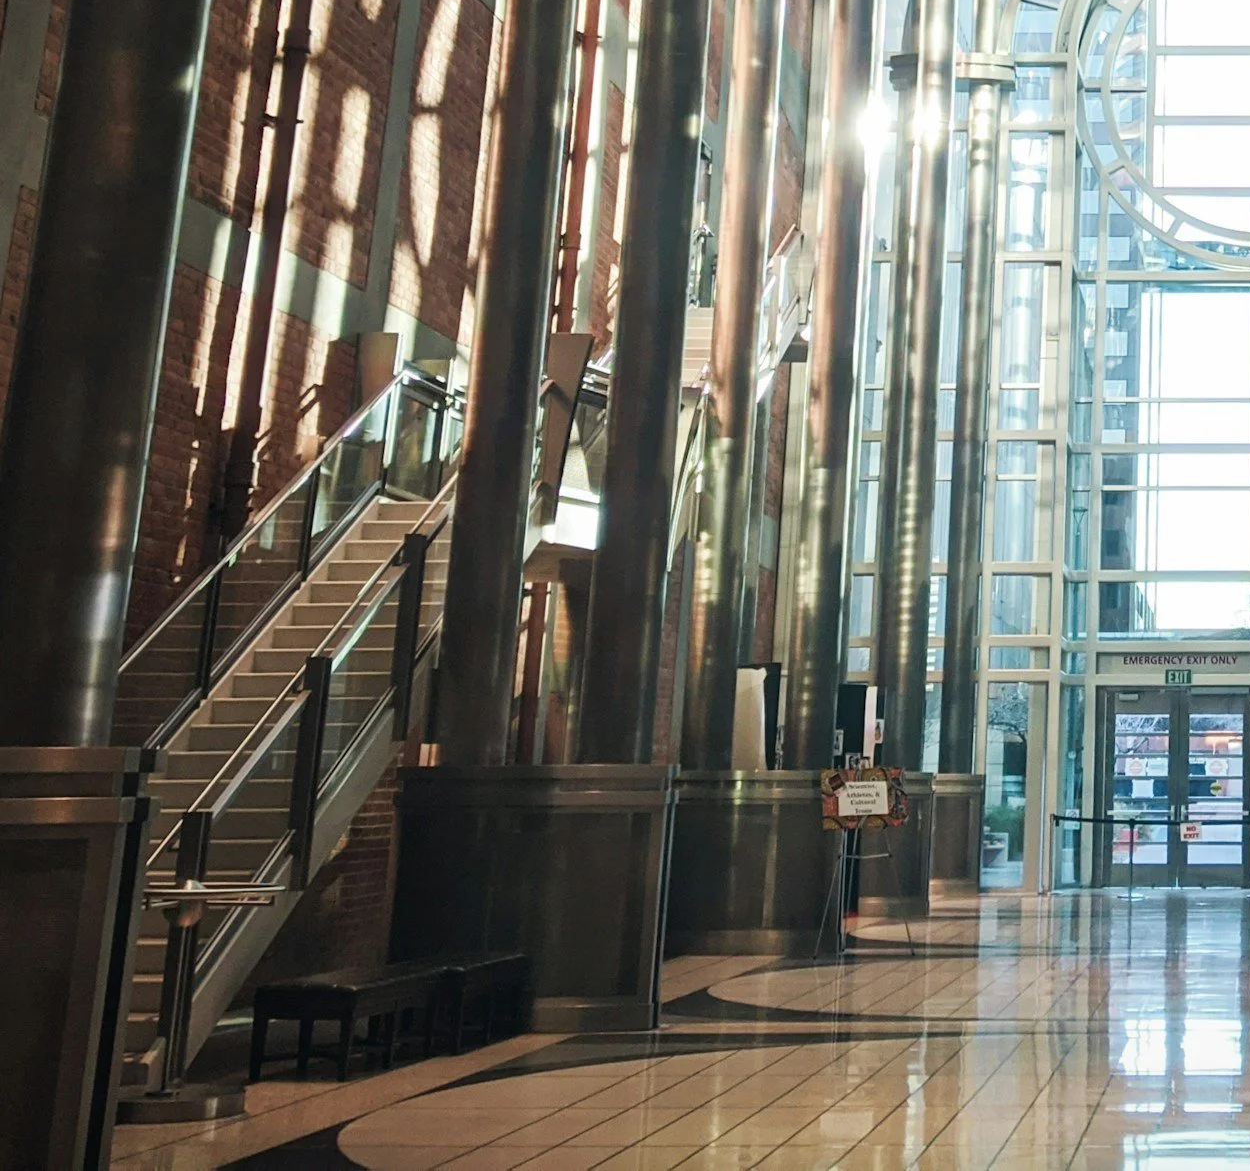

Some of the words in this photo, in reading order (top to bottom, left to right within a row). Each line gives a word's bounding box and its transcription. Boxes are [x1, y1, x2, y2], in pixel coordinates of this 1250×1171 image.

[1123, 655, 1184, 665] EMERGENCY
[1186, 655, 1207, 665] EXIT
[1210, 655, 1239, 665] ONLY
[1168, 670, 1189, 684] EXIT
